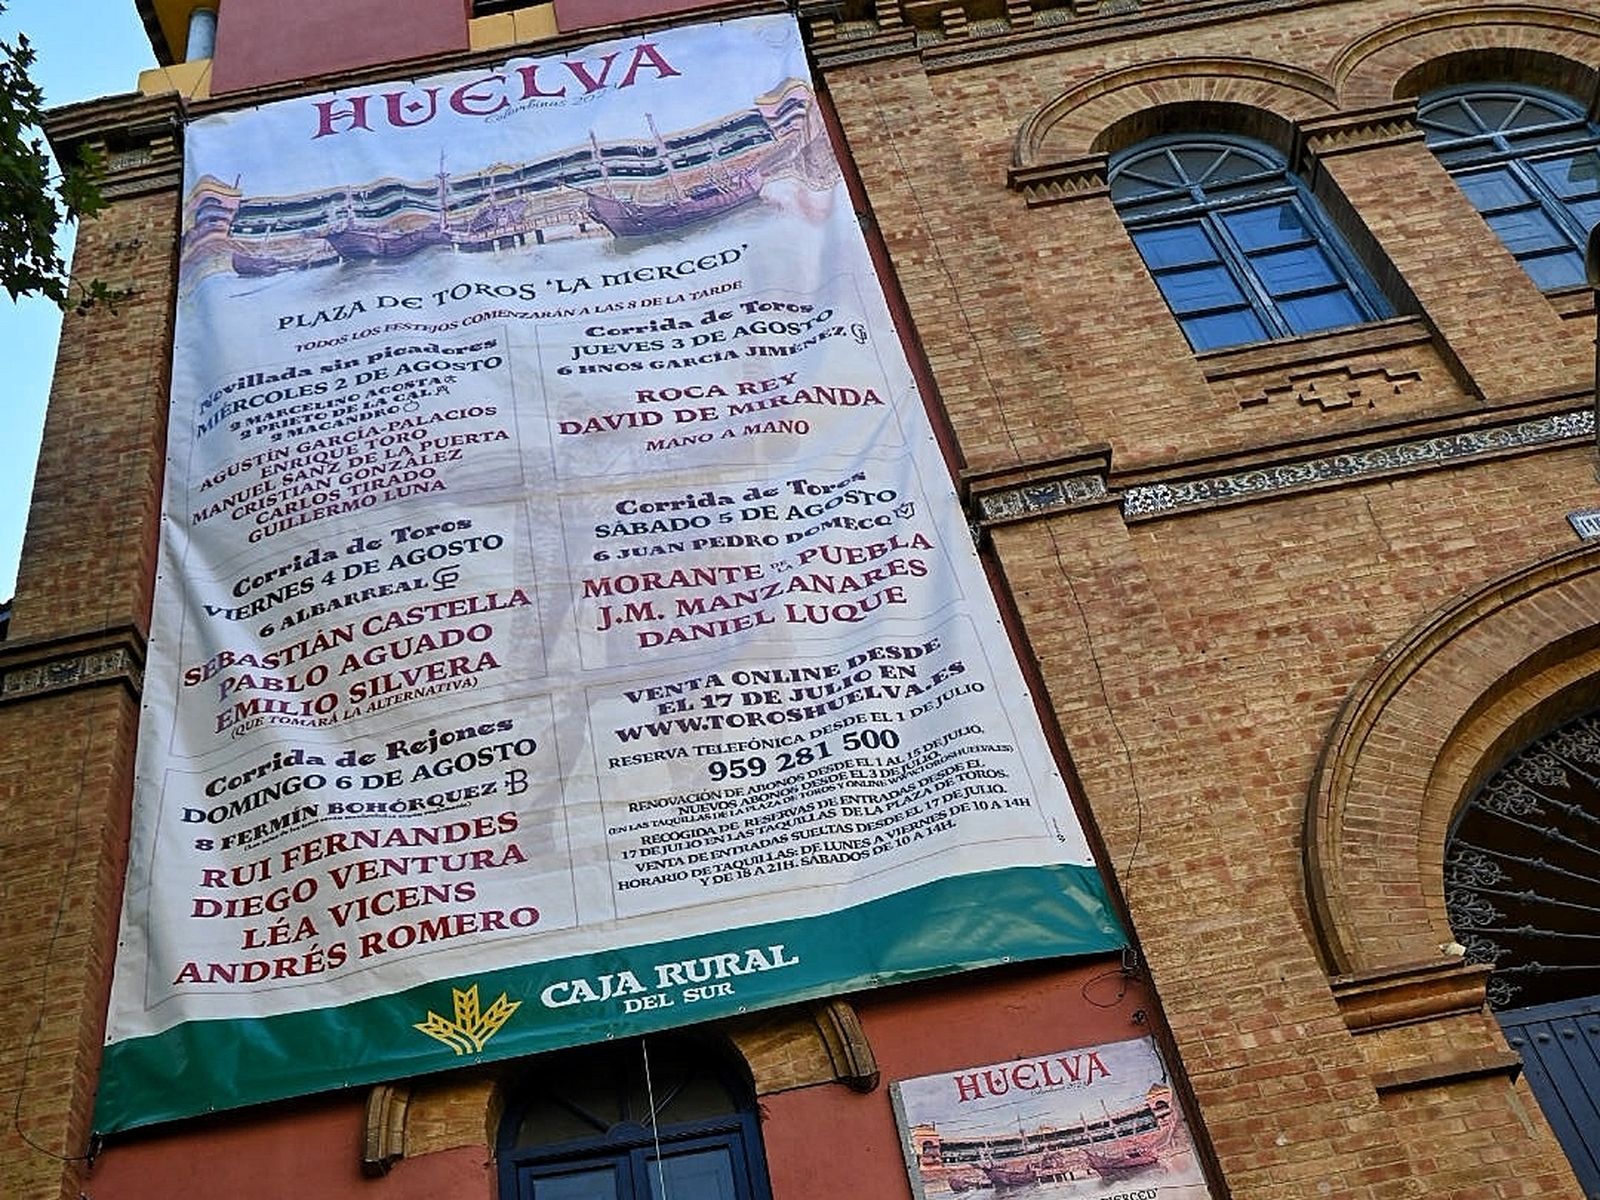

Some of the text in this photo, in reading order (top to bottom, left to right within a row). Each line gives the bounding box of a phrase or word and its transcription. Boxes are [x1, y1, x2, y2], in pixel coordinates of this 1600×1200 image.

[311, 42, 681, 139] HUELVA
[278, 243, 748, 330] PLAZA DE TOROS 'LA MERCED'
[295, 281, 742, 352] TODOS LOS FESTEJOS COMENZARÁN A LAS 8 DE LA TARDE
[585, 301, 814, 338] Corrida de Toros
[557, 324, 847, 376] 6 HNOS GARCÍA JIMÉNEZ
[571, 309, 833, 360] JUEVES 3 DE AGOSTO
[196, 356, 503, 439] MIÉRCOLES 2 DE AGOSTO
[200, 339, 497, 413] Novillada sin picadores
[636, 372, 798, 403] ROCA REY
[558, 386, 885, 435] DAVID DE MIRANDA
[646, 420, 810, 451] MANO A MANO
[192, 429, 510, 525] MANUEL SANZ DE LA PUERTA
[200, 406, 498, 493] AGUSTÍN GARCÍA-PALACIOS
[260, 428, 427, 479] ENRIQUE TORO
[232, 448, 462, 521] CRISTIAN GONZÁLEZ
[249, 479, 447, 543] GUILLERMO LUNA
[256, 467, 436, 525] CARLOS TIRADO
[594, 489, 898, 539] SÁBADO 5 DE AGOSTO
[615, 472, 866, 516] Corrida de Toros
[233, 517, 472, 597] Corrida de Toros
[582, 532, 935, 599] MORANTE PUEBLA
[593, 513, 893, 562] 6 JUAN PEDRO DOMECQ
[202, 534, 504, 621] VIERNES 4 DE AGOSTO
[259, 578, 428, 637] 6 ALBARREAL
[597, 558, 930, 631] J.M. MANZANARES
[184, 589, 532, 687] SEBASTIÁN CASTELLA
[637, 586, 908, 648] DANIEL LUQUE
[215, 650, 502, 733] EMILIO SILVERA
[218, 623, 493, 700] PABLO AGUADO
[624, 637, 942, 704] VENTA ONLINE DESDE
[657, 665, 917, 715] EL 17 DE JULIO EN
[608, 682, 985, 769] RESERVA TELEFÓNICA DESDE EL 1 DE JULIO
[614, 660, 966, 743] WWW.TOROSHUELVA.ES
[180, 738, 538, 825] DOMINGO 6 DE AGOSTO
[205, 718, 514, 798] Corrida de Rejones
[708, 729, 899, 782] 959 281 500
[194, 838, 214, 851] 8
[221, 803, 319, 850] FERMÍN
[327, 781, 498, 815] BOHÓRQUEZ
[628, 773, 804, 812] RENOVACIÓN DE ABONOS
[191, 843, 528, 920] DIEGO VENTURA
[201, 858, 272, 888] RUI
[281, 811, 518, 873] FERNANDES
[173, 906, 541, 985] ANDRÉS ROMERO
[241, 881, 476, 949] LÉA VICENS
[540, 945, 799, 1009] CAJA RURAL
[623, 983, 735, 1015] DEL SUR
[953, 1052, 1112, 1103] HUELVA
